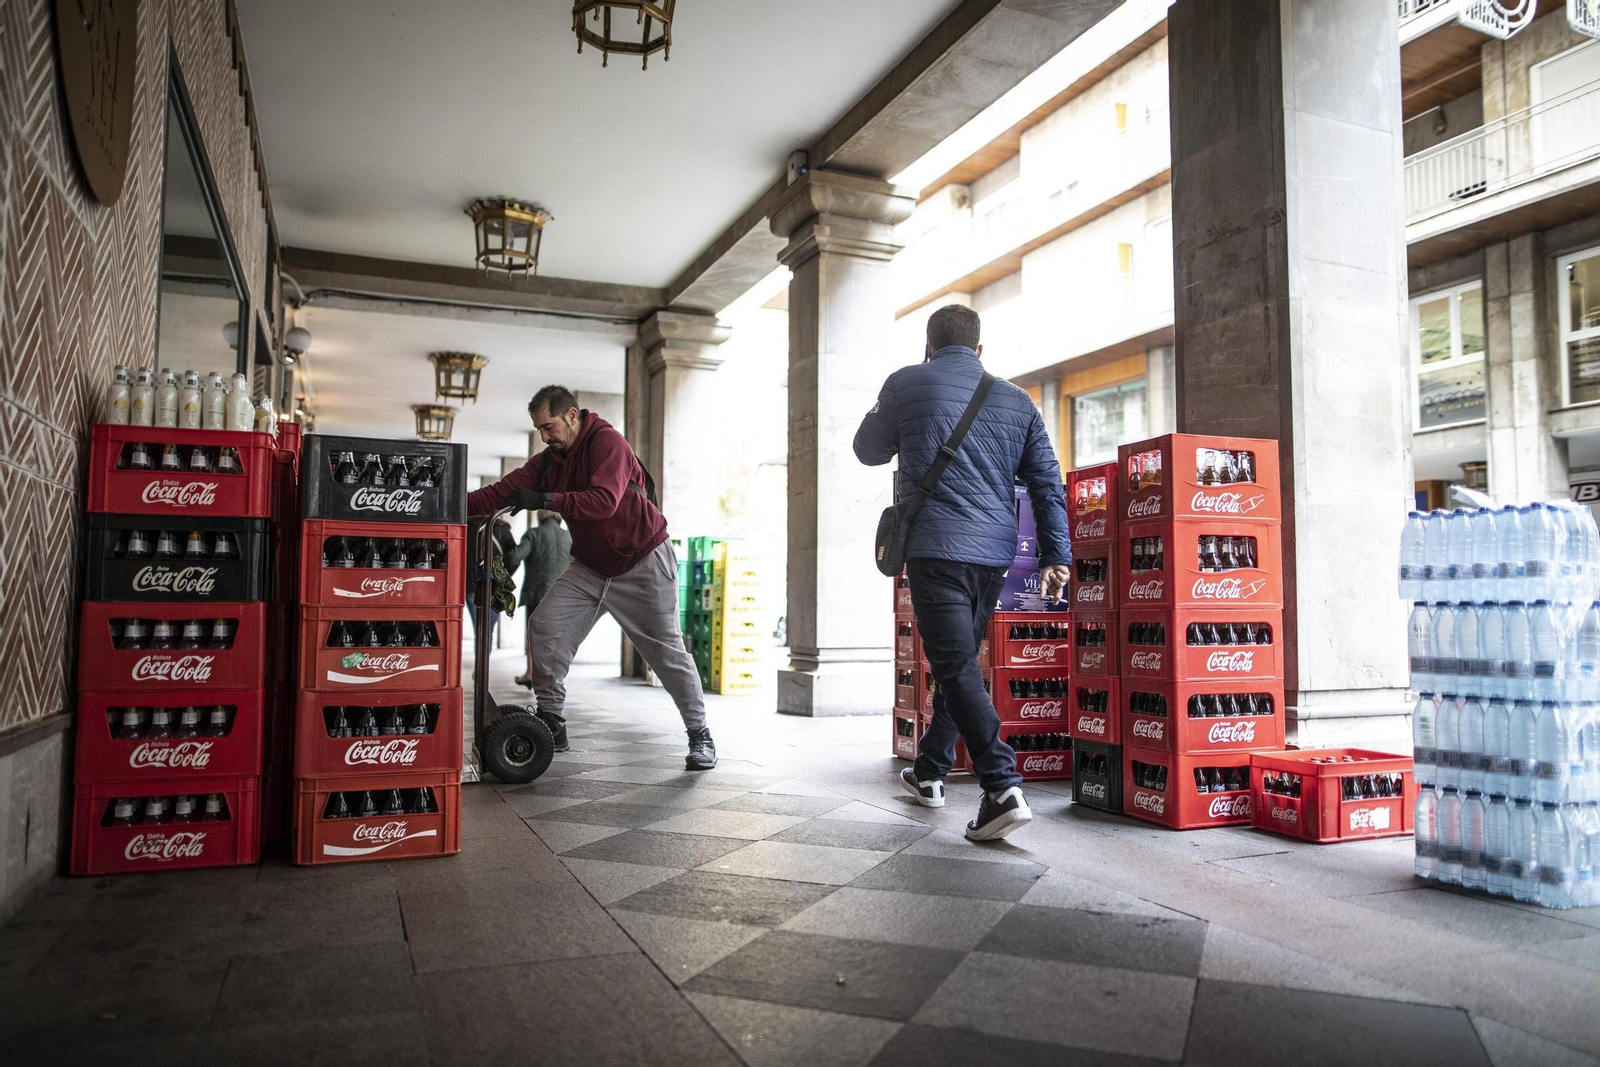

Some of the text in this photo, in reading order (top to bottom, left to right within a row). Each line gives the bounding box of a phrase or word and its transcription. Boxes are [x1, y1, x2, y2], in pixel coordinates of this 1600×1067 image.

[142, 480, 219, 505] Coca-Cola
[350, 487, 424, 513] Coca-Cola
[1191, 491, 1242, 513] Coca-Cola
[1128, 494, 1162, 518] Coca-Cola
[1075, 518, 1106, 538] Coca-Cola
[132, 566, 218, 592] Coca-Cola
[361, 577, 404, 592] Coca-Cola
[1129, 580, 1164, 599] Coca-Cola
[1192, 578, 1243, 599] Coca-Cola
[1022, 644, 1056, 658] Coca-Cola
[1132, 651, 1162, 670] Coca-Cola
[1207, 651, 1254, 672] Coca-Cola
[132, 655, 216, 682] Coca-Cola
[1020, 700, 1063, 719] Coca-Cola
[1078, 716, 1106, 735] Coca-Cola
[1134, 719, 1164, 739] Coca-Cola
[1208, 720, 1256, 744] Coca-Cola
[130, 742, 214, 768] Coca-Cola
[344, 739, 420, 766] Coca-Cola
[1023, 754, 1065, 772] Coca-Cola
[1082, 782, 1105, 798] Coca-Cola
[1134, 791, 1166, 814] Coca-Cola
[1209, 794, 1250, 818] Coca-Col
[352, 820, 408, 842] Coca-Cola
[124, 832, 207, 860] Coca-Cola
